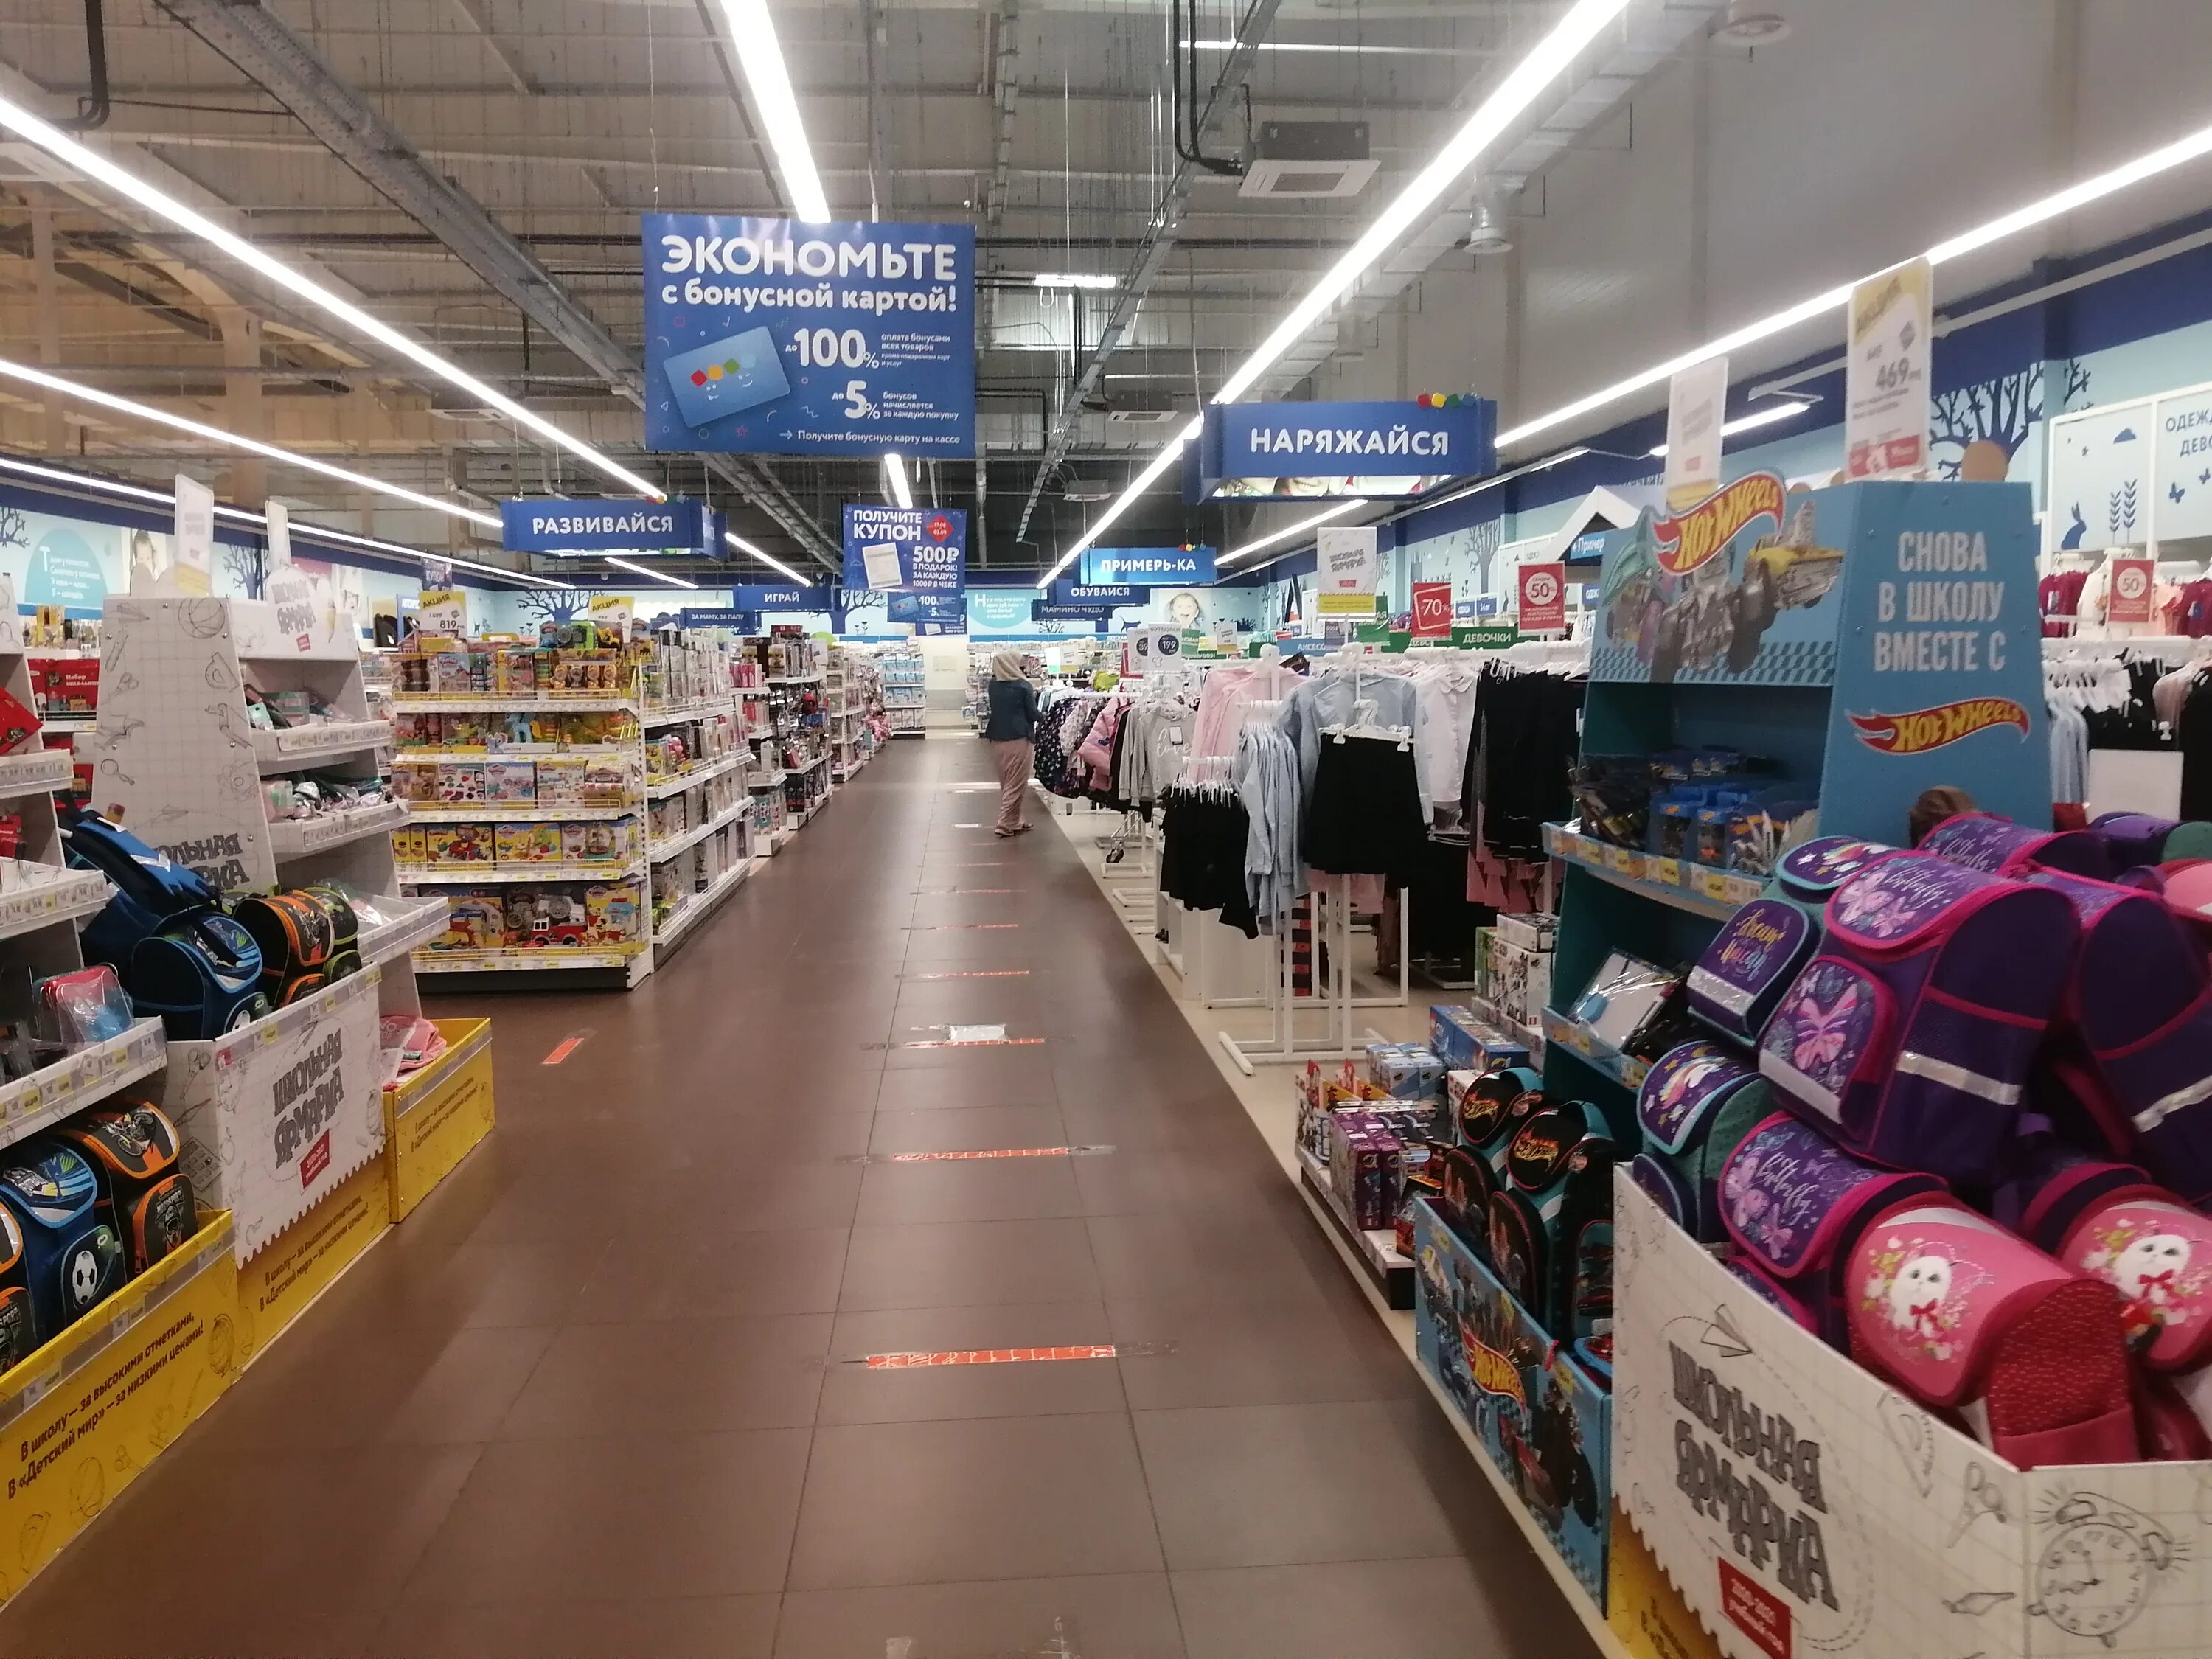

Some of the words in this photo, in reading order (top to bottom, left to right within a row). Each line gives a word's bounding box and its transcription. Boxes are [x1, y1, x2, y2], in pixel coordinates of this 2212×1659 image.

[661, 234, 957, 282] ЭКОНОМЬТЕ
[662, 283, 678, 305] с
[684, 276, 834, 313] бонусной
[841, 285, 958, 317] картой!
[785, 344, 798, 353] до
[793, 327, 880, 369] 100%
[881, 334, 910, 342] оплата
[911, 333, 951, 344] бонусами
[832, 392, 844, 400] до
[844, 380, 881, 420] 5%
[893, 411, 925, 420] каждую
[925, 412, 959, 422] покупку
[2166, 408, 2212, 433] ОДЕЖ
[797, 429, 844, 442] Получите
[846, 431, 894, 443] бонусную
[894, 435, 921, 445] карту
[1251, 422, 1450, 456] НАРЯЖАЙСЯ
[2180, 434, 2212, 458] ДЕВО
[532, 512, 673, 535] РАЗВИВАЙСЯ
[853, 509, 922, 524] ПОЛУЧИТЕ
[853, 523, 922, 541] КУПОН
[1578, 537, 1605, 554] Пример
[1897, 530, 1988, 572] СНОВА
[918, 563, 958, 571] ПОДАРОК!
[923, 572, 958, 580] КАЖДУЮ
[1101, 558, 1197, 573] ПРИМЕРЬ-КА
[422, 594, 451, 608] АКЦИЯ
[591, 598, 620, 612] АКЦИЯ
[765, 591, 800, 602] ИГРАЙ
[1878, 581, 1896, 622] В
[1906, 581, 2006, 622] ШКОЛУ
[439, 620, 457, 629] 819
[1162, 640, 1176, 650] 199
[1463, 633, 1512, 644] ДЕВОЧКИ
[1874, 630, 1980, 672] ВМЕСТЕ
[1988, 630, 2006, 671] С
[152, 833, 243, 866] ОЛЬНАЯ
[273, 1028, 343, 1117] ШКОЛЬНАЯ
[274, 1066, 344, 1169] ЯРМАРКА
[21, 1440, 29, 1463] В
[31, 1413, 68, 1453] школу
[80, 1394, 91, 1412] за
[93, 1353, 144, 1402] высокими
[145, 1312, 195, 1358] отметками,
[8, 1478, 16, 1500] В
[19, 1430, 76, 1488] «Детский
[77, 1408, 105, 1439] мир»
[115, 1390, 126, 1407] за
[127, 1354, 168, 1396] низкими
[169, 1319, 204, 1361] ценами!
[1669, 1340, 1829, 1516] ШКОЛЬНАЯ
[1675, 1420, 1841, 1613] ЯРМАРКА
